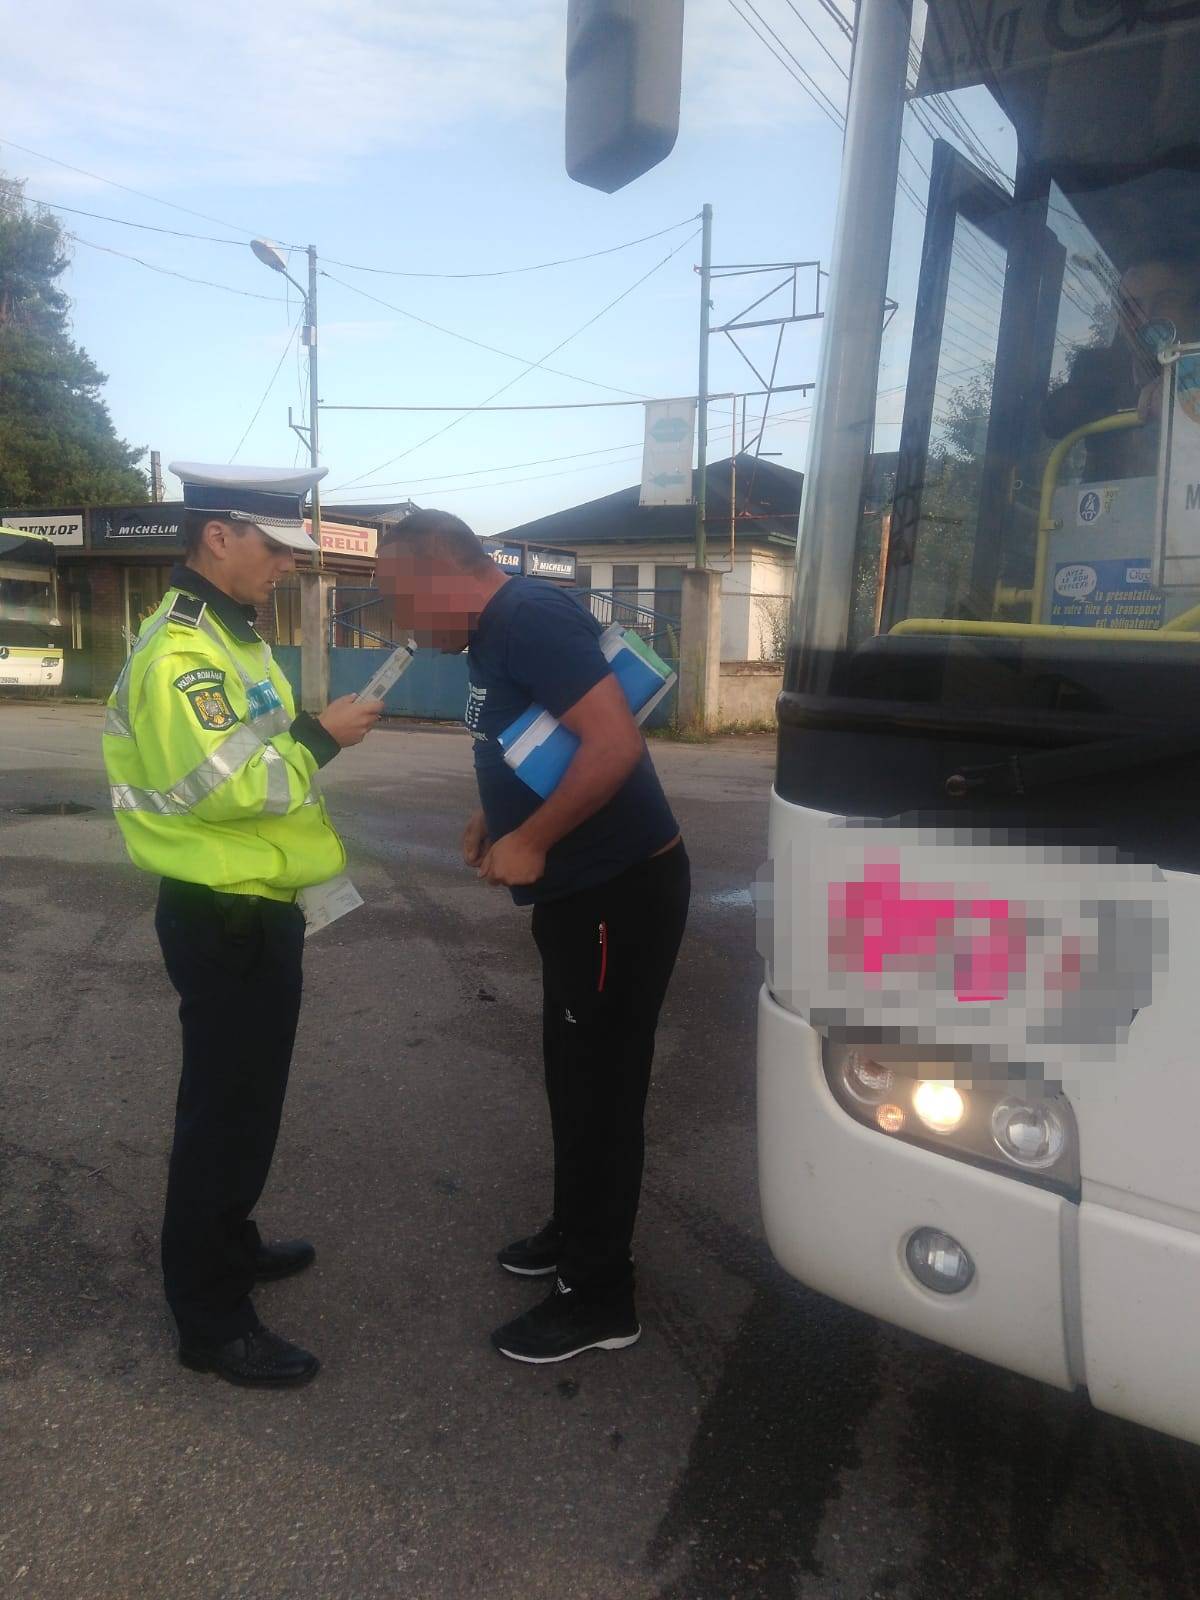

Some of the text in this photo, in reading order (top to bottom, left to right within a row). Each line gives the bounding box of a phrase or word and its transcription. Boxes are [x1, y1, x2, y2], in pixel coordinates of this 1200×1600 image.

[119, 525, 178, 535] MICHELIN
[321, 534, 369, 553] RELLI
[491, 552, 520, 566] YEAR
[539, 562, 573, 573] MICHELIN
